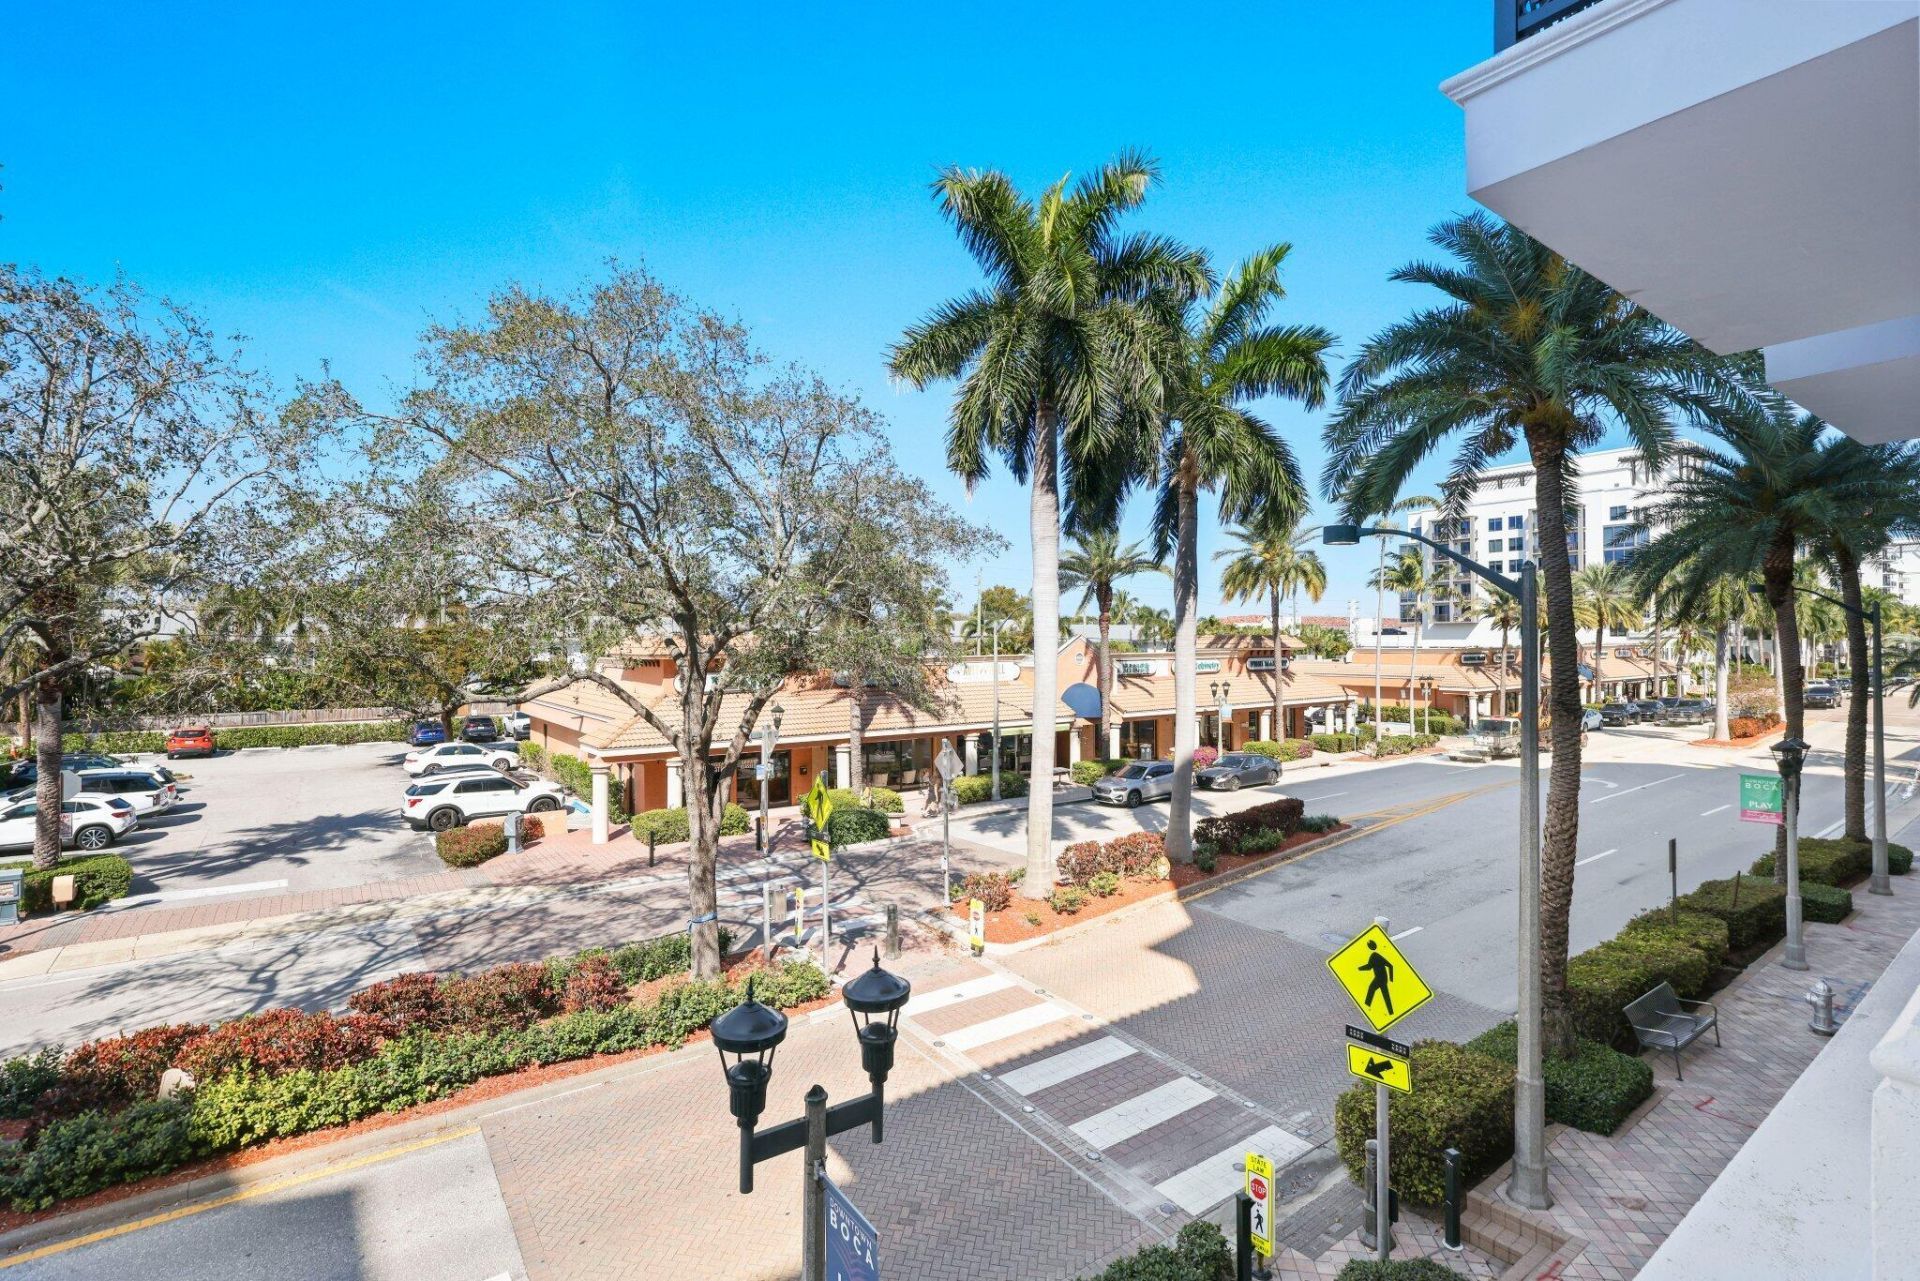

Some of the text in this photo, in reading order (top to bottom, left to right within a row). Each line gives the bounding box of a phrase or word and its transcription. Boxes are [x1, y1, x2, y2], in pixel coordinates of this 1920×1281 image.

[1745, 782, 1777, 791] BOCA
[1749, 800, 1774, 810] PLAY
[1251, 1156, 1267, 1169] STATE
[1253, 1164, 1265, 1174] LAW
[1251, 1182, 1266, 1195] STOP
[830, 1197, 873, 1250] DOWNTOWN
[830, 1208, 874, 1271] BOCA
